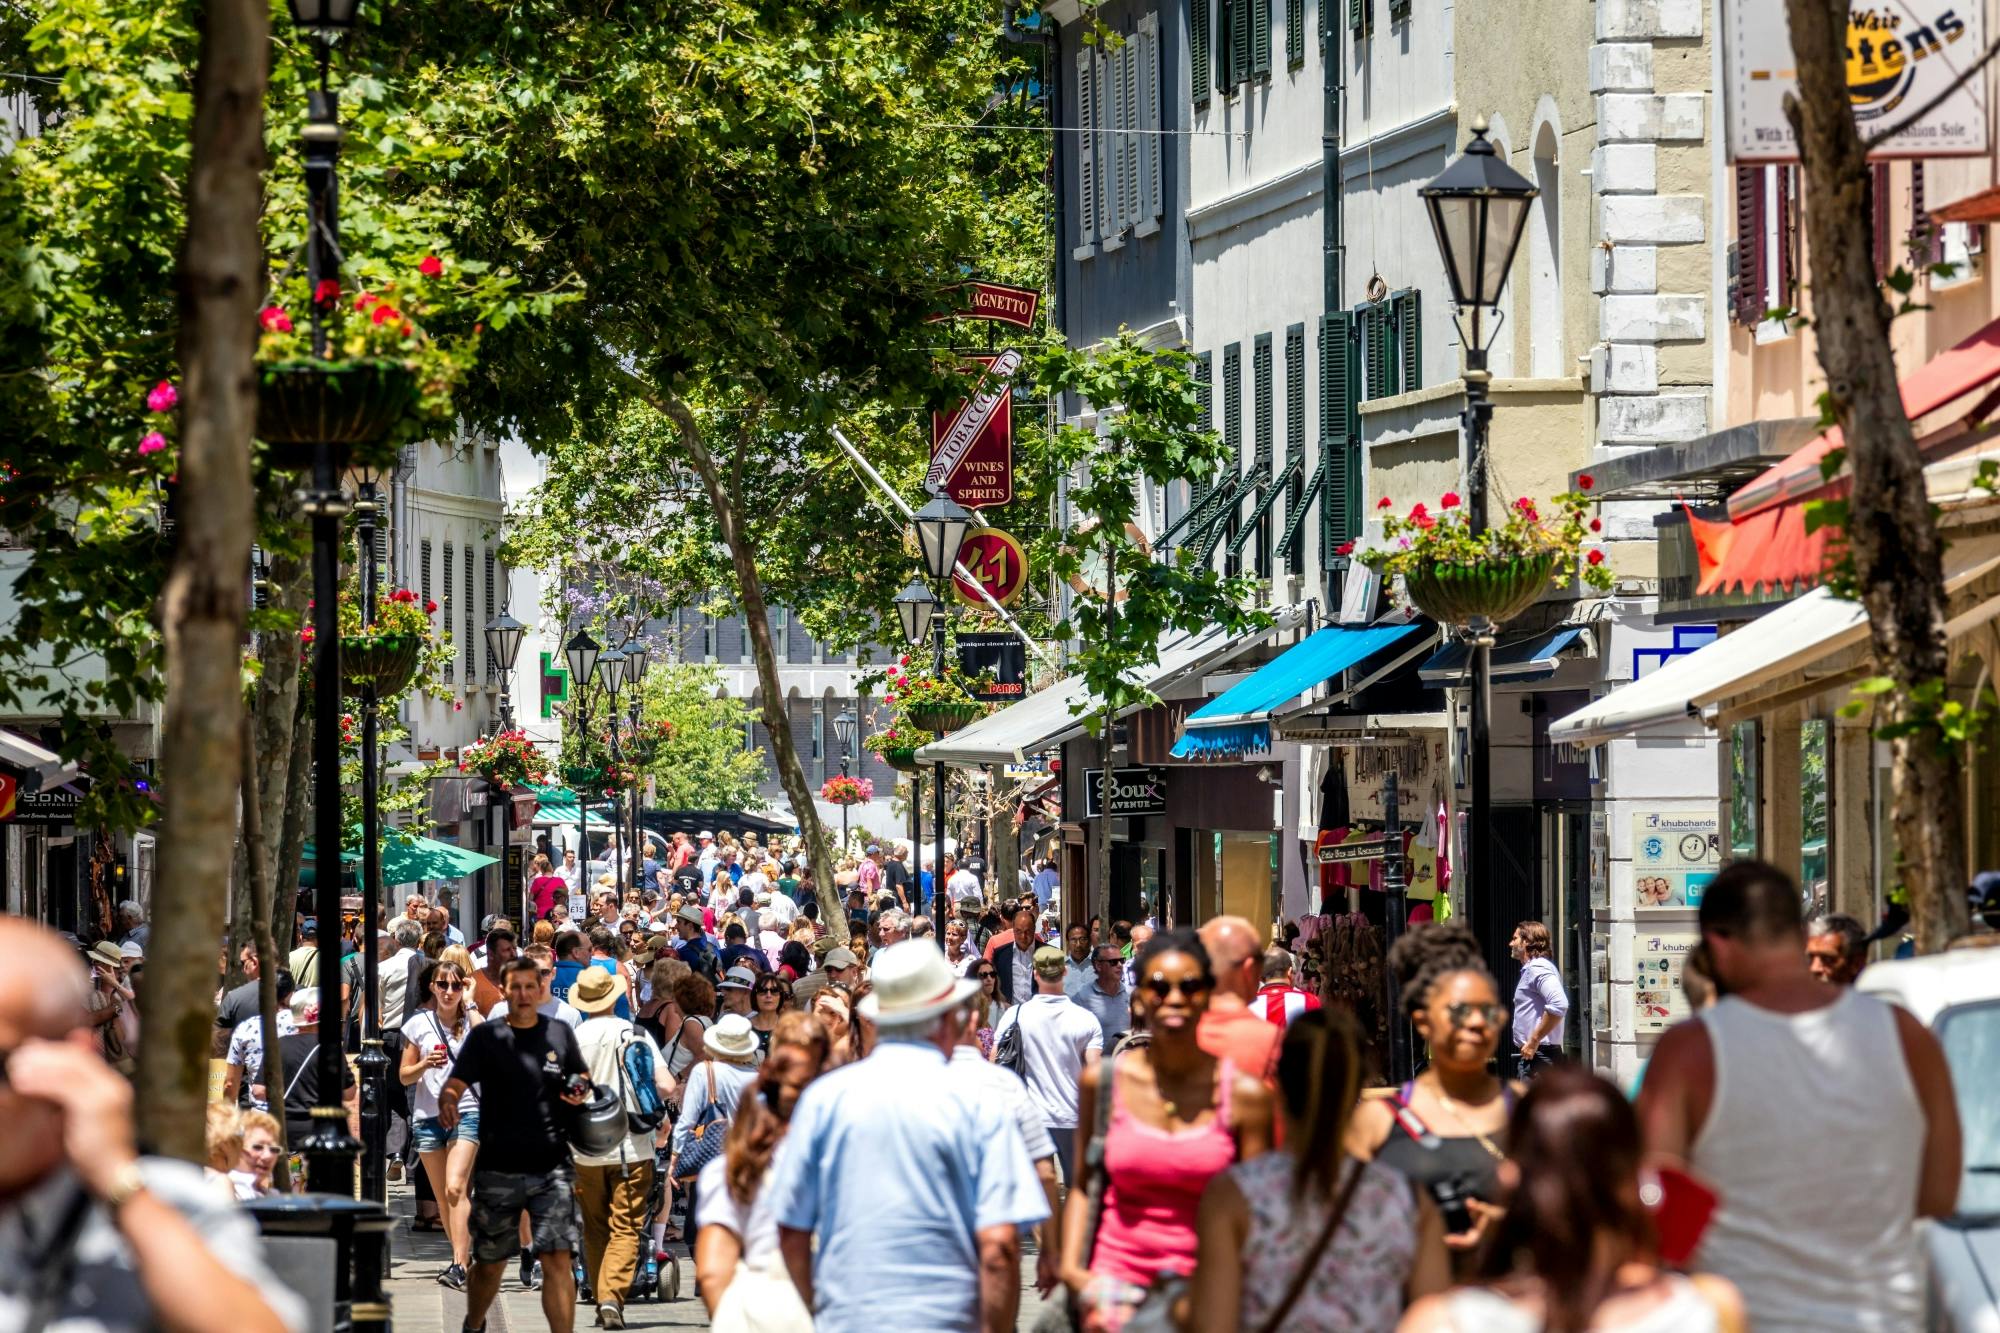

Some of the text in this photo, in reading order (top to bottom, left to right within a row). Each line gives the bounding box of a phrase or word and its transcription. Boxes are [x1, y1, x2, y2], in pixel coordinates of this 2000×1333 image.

[1755, 127, 1784, 143] With
[1941, 122, 1965, 137] Sole
[964, 462, 1004, 472] WINES
[971, 475, 997, 485] AND
[958, 488, 1005, 499] SPIRITS
[964, 545, 1007, 588] 41
[1096, 776, 1165, 800] Boux
[1110, 801, 1150, 809] AVENUE
[1661, 819, 1717, 827] khubchands
[683, 879, 691, 890] 9
